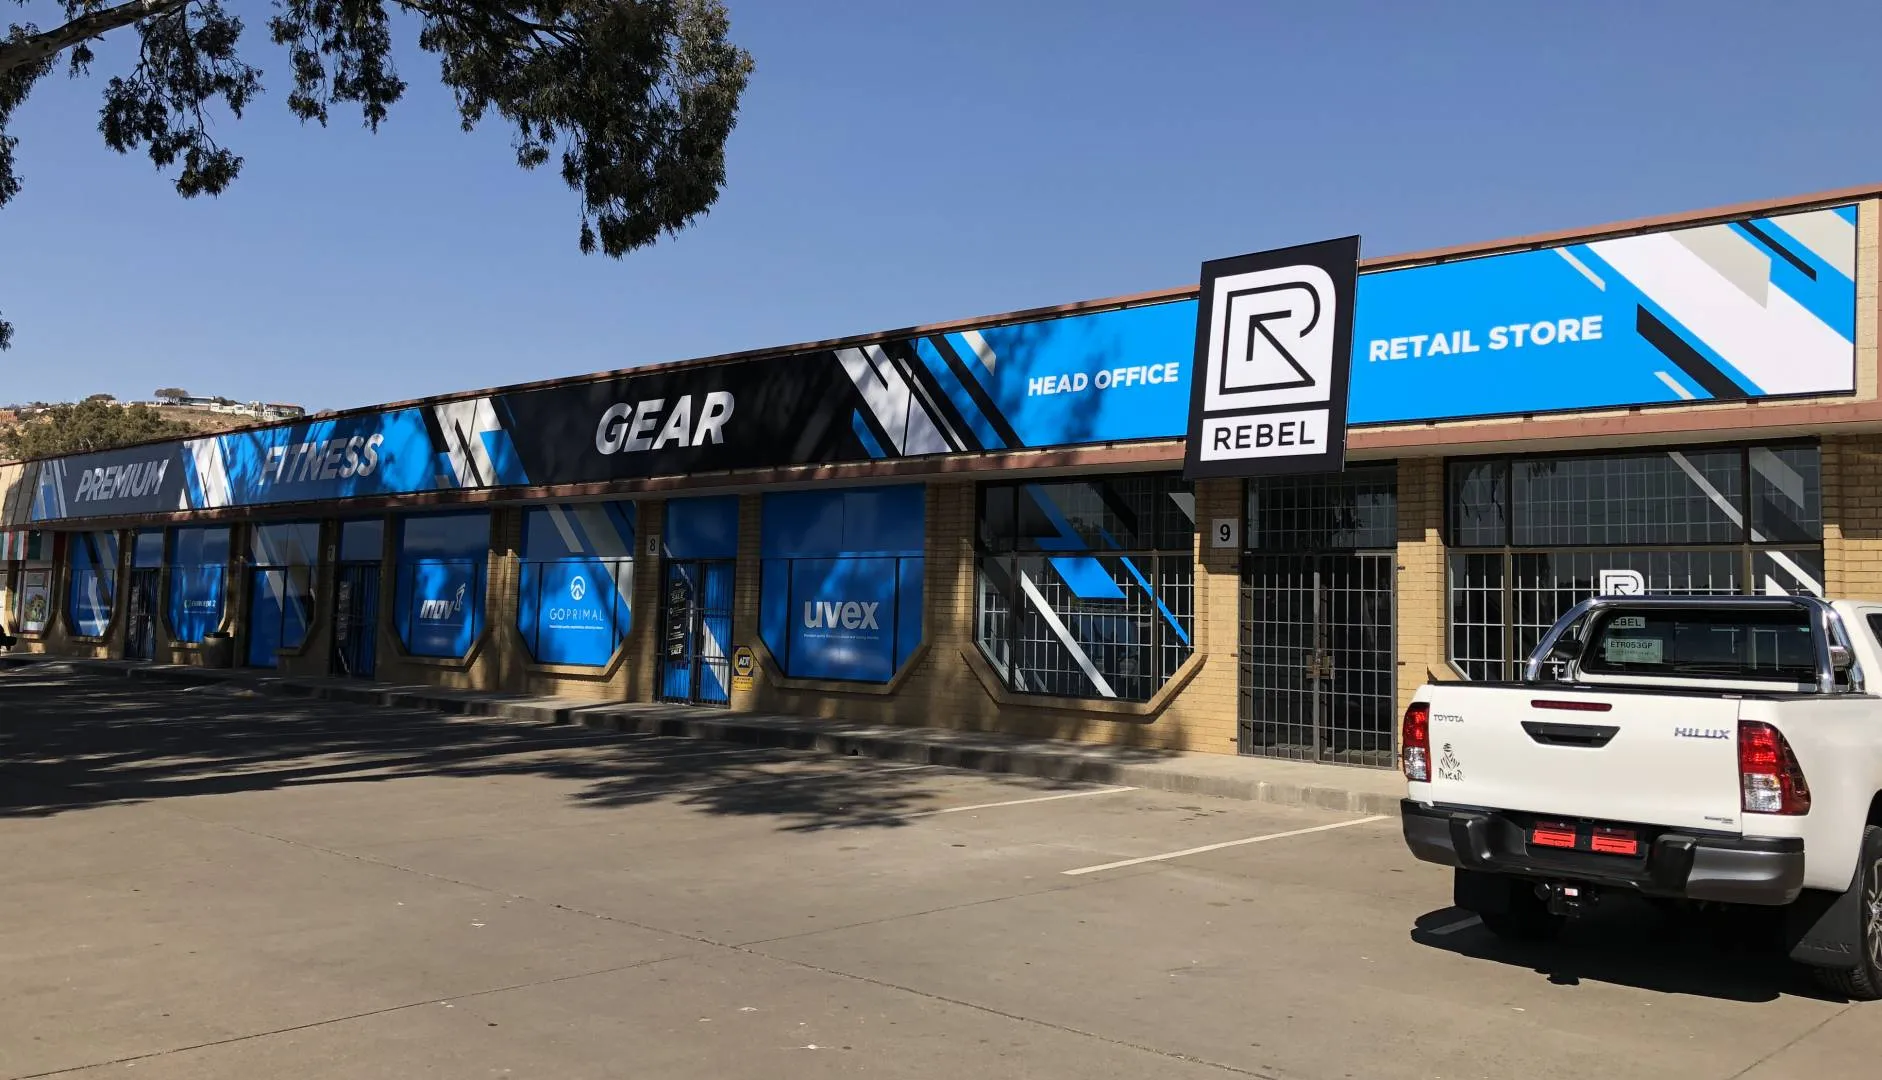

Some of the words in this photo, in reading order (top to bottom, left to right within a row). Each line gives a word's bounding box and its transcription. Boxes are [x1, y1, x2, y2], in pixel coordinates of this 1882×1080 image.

[1369, 330, 1480, 362] RETAIL
[1488, 315, 1604, 350] STORE
[1027, 372, 1089, 397] HEAD
[1094, 362, 1180, 390] OFFICE
[595, 391, 735, 455] GEAR
[1213, 420, 1316, 451] REBEL
[258, 433, 385, 486] FITNESS
[75, 459, 170, 502] PREMIUM
[649, 538, 656, 551] 8
[1219, 523, 1231, 542] 9
[549, 608, 604, 621] GOPRIMAL
[804, 601, 879, 630] uvex
[1433, 714, 1465, 723] TOYOTA
[1674, 727, 1731, 740] HILUX
